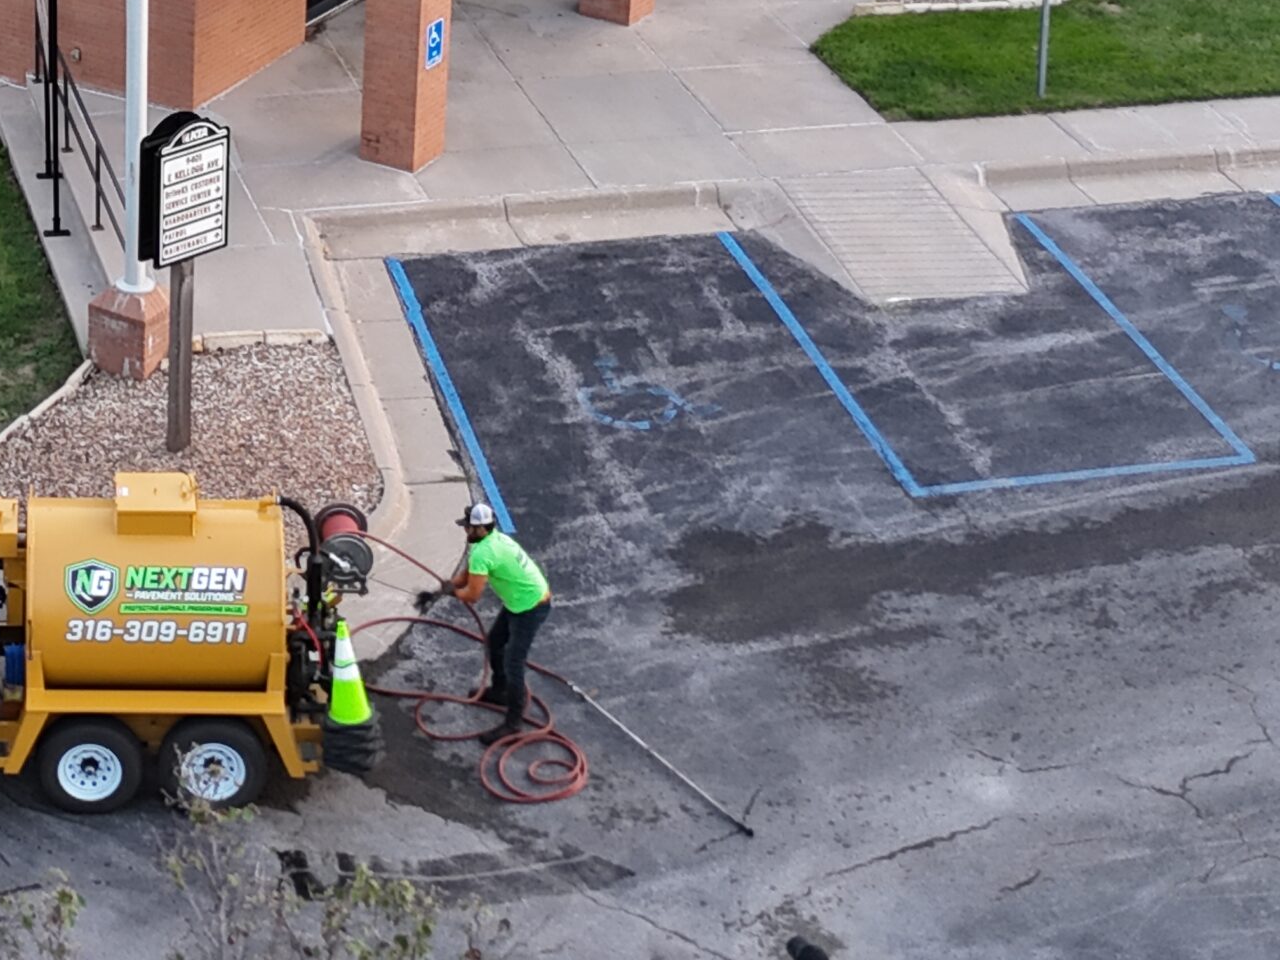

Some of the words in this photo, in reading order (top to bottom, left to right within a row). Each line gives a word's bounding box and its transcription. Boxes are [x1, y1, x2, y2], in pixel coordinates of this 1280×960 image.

[175, 163, 204, 179] KELLOGG
[207, 158, 219, 169] AVE
[190, 175, 220, 191] CUSTOMER
[165, 196, 188, 210] SERVICE
[190, 189, 211, 202] CENTER
[165, 206, 211, 226] HEADQUARTERS
[165, 228, 187, 240] PATROL
[164, 236, 208, 255] MAINTENANCE
[75, 569, 111, 597] NG
[125, 566, 246, 591] NEXTGEN
[134, 591, 182, 600] PAVEMENT
[184, 591, 235, 602] SOLUTIONS
[65, 620, 247, 643] 316-309-6911
